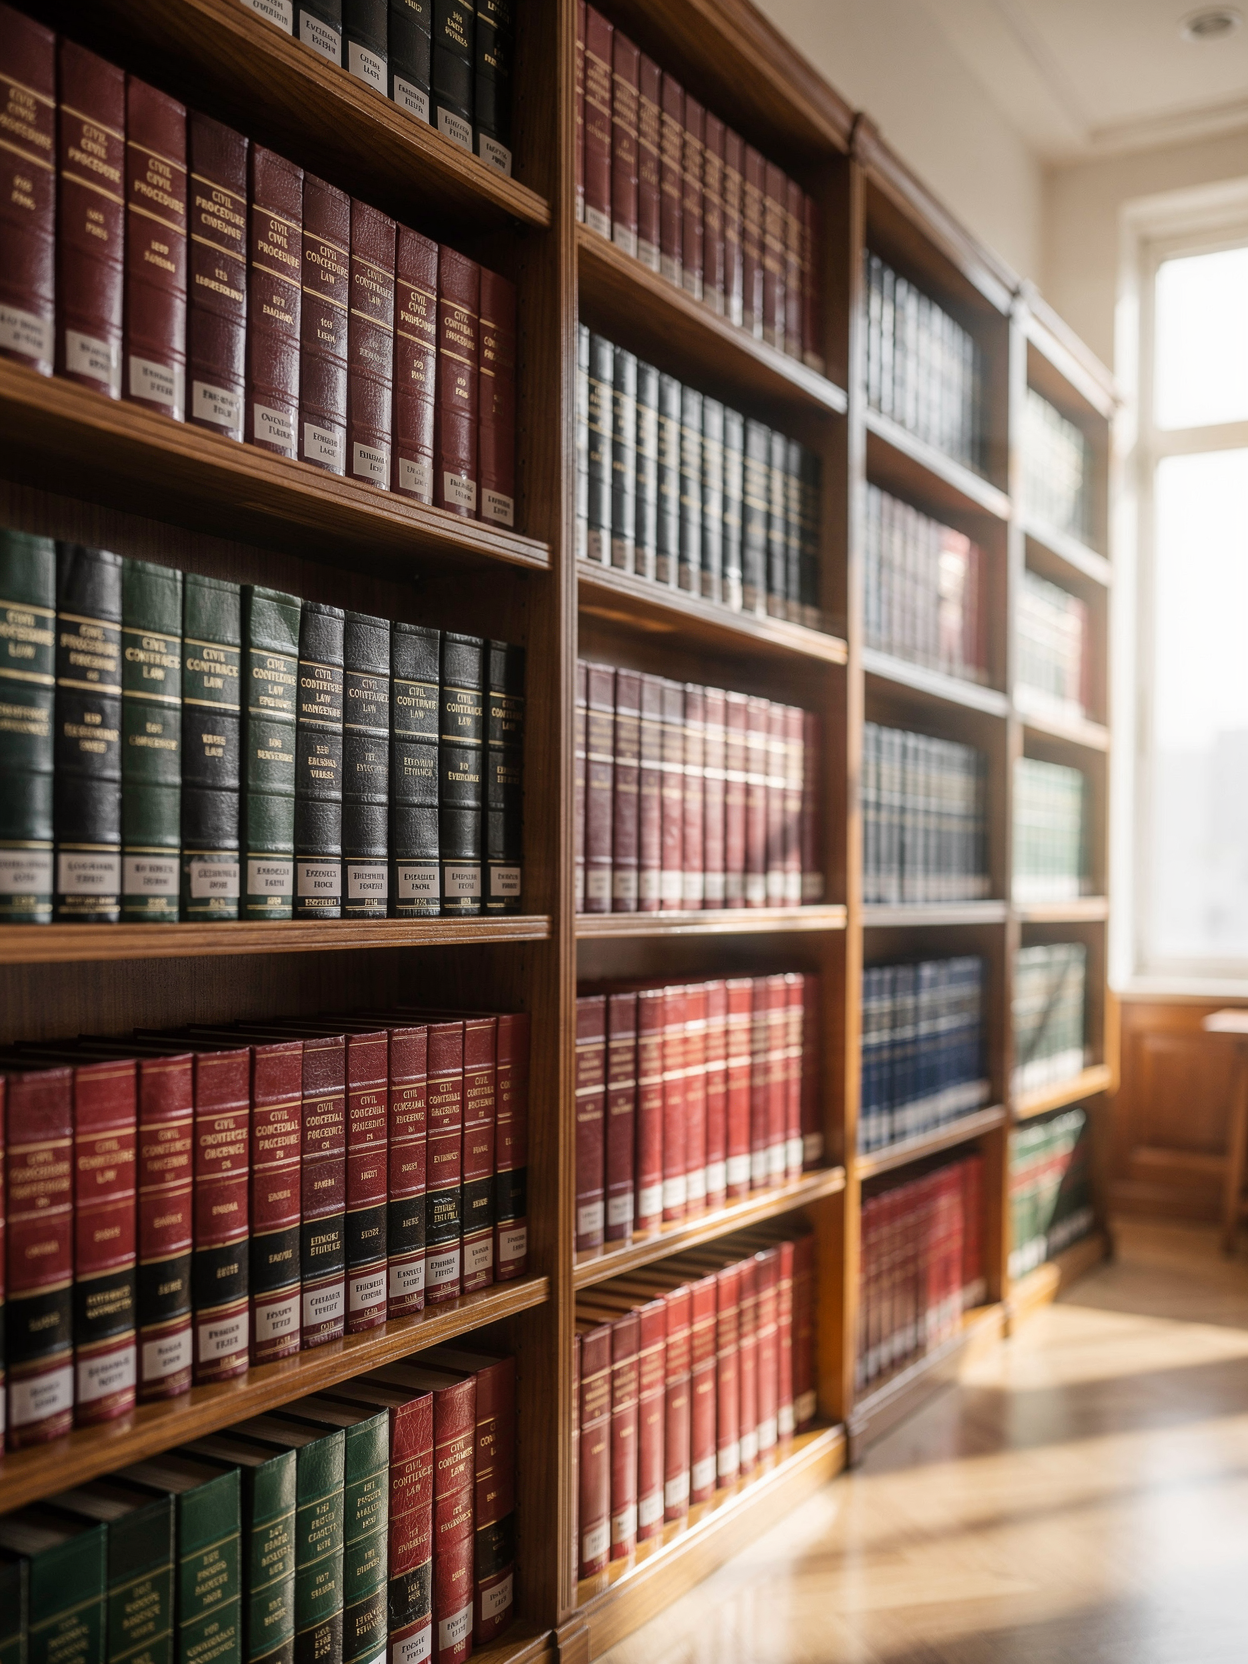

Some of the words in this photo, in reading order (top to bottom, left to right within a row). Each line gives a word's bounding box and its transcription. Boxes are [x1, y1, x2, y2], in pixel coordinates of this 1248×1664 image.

[83, 124, 108, 147] CIVIL
[148, 158, 172, 180] CIVIL
[134, 180, 185, 216] PROCEDURE
[212, 191, 233, 209] CIVIL
[196, 196, 246, 228] PROCEDURE
[270, 220, 288, 236] CIVIL
[268, 231, 288, 248] CIVIL
[410, 292, 427, 306] CIVIL
[203, 648, 226, 662] CIVIL
[203, 675, 225, 689] LAW
[410, 709, 425, 720] LAW
[270, 1110, 289, 1122] CIVIL
[214, 1118, 236, 1131] CIVIL
